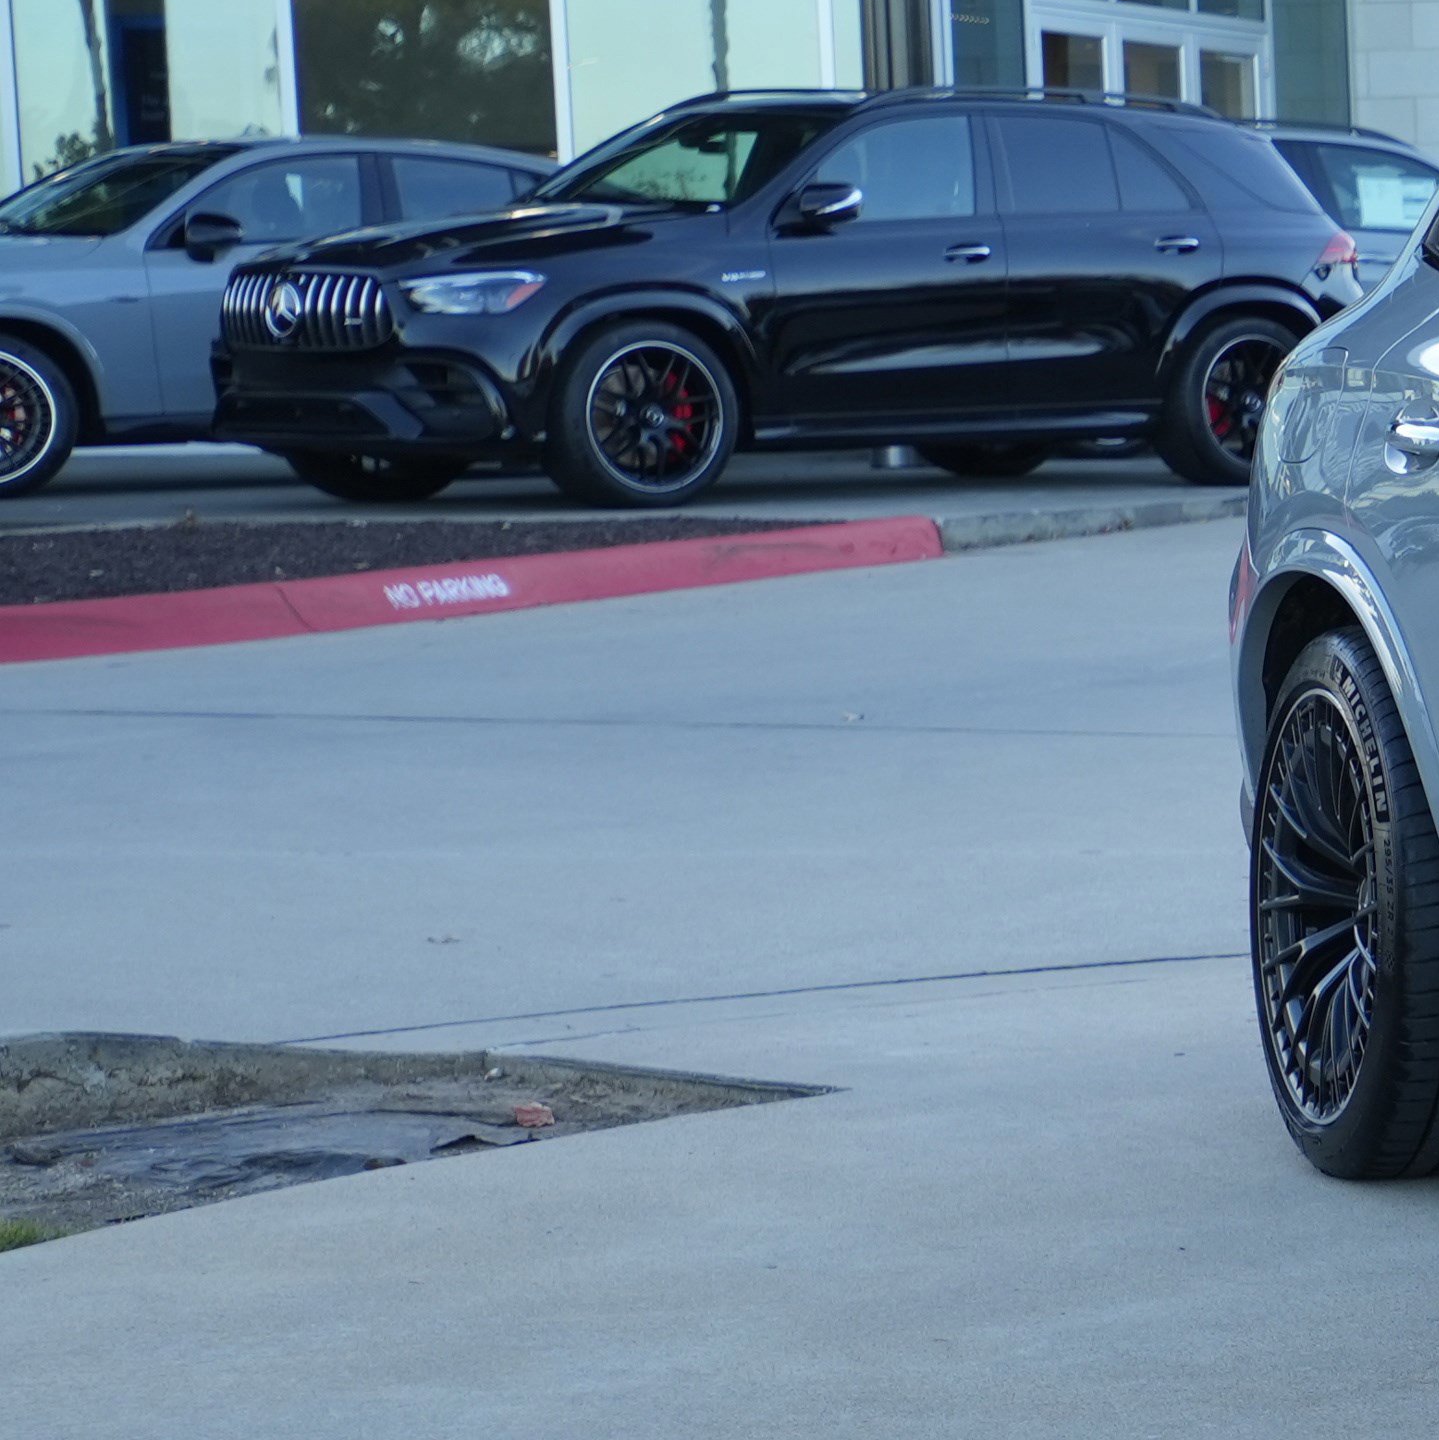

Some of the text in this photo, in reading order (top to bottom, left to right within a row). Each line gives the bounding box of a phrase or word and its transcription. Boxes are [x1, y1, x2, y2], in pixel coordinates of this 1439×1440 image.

[383, 573, 509, 610] NO PARKING
[1342, 676, 1388, 812] MICHELIN
